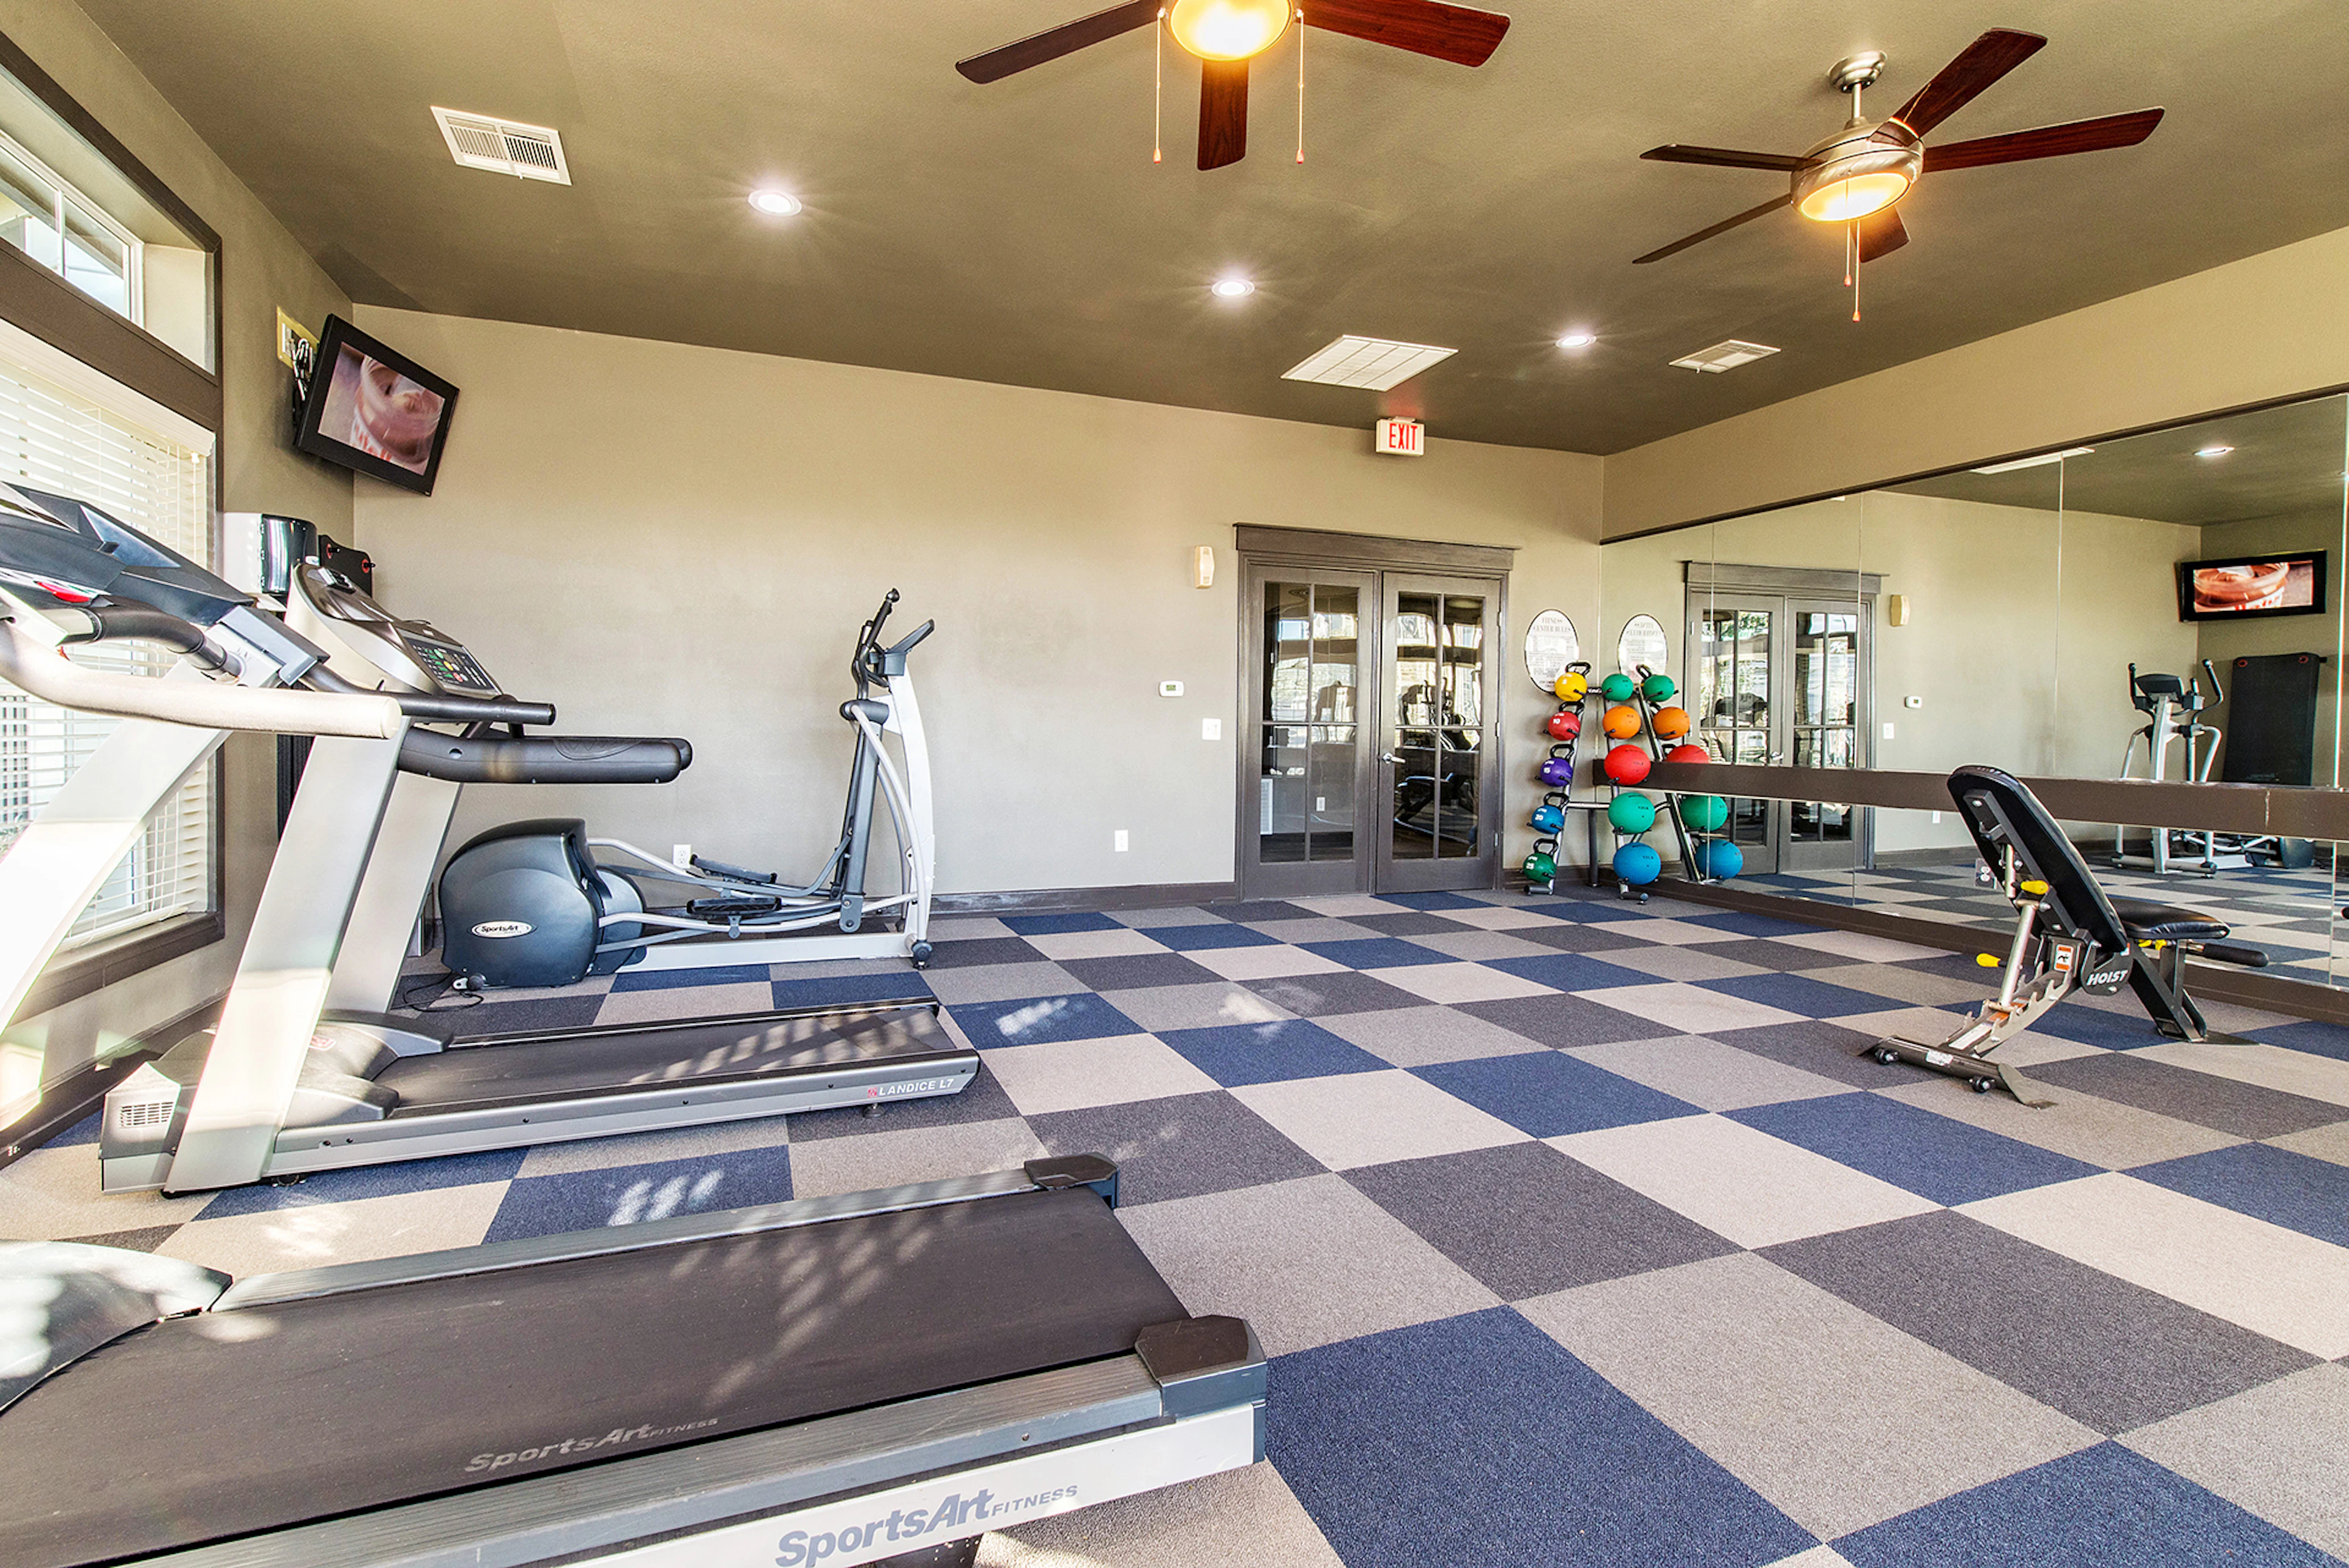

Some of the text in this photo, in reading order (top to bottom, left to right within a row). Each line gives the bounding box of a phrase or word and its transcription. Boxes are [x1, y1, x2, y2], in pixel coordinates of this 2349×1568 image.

[1389, 423, 1418, 451] EXIT
[2087, 969, 2128, 986] HOIST
[878, 1078, 954, 1096] LANDICE L7
[464, 1418, 718, 1473] SportsArt FITNESS
[776, 1484, 1078, 1568] SportsArt FITNESS
